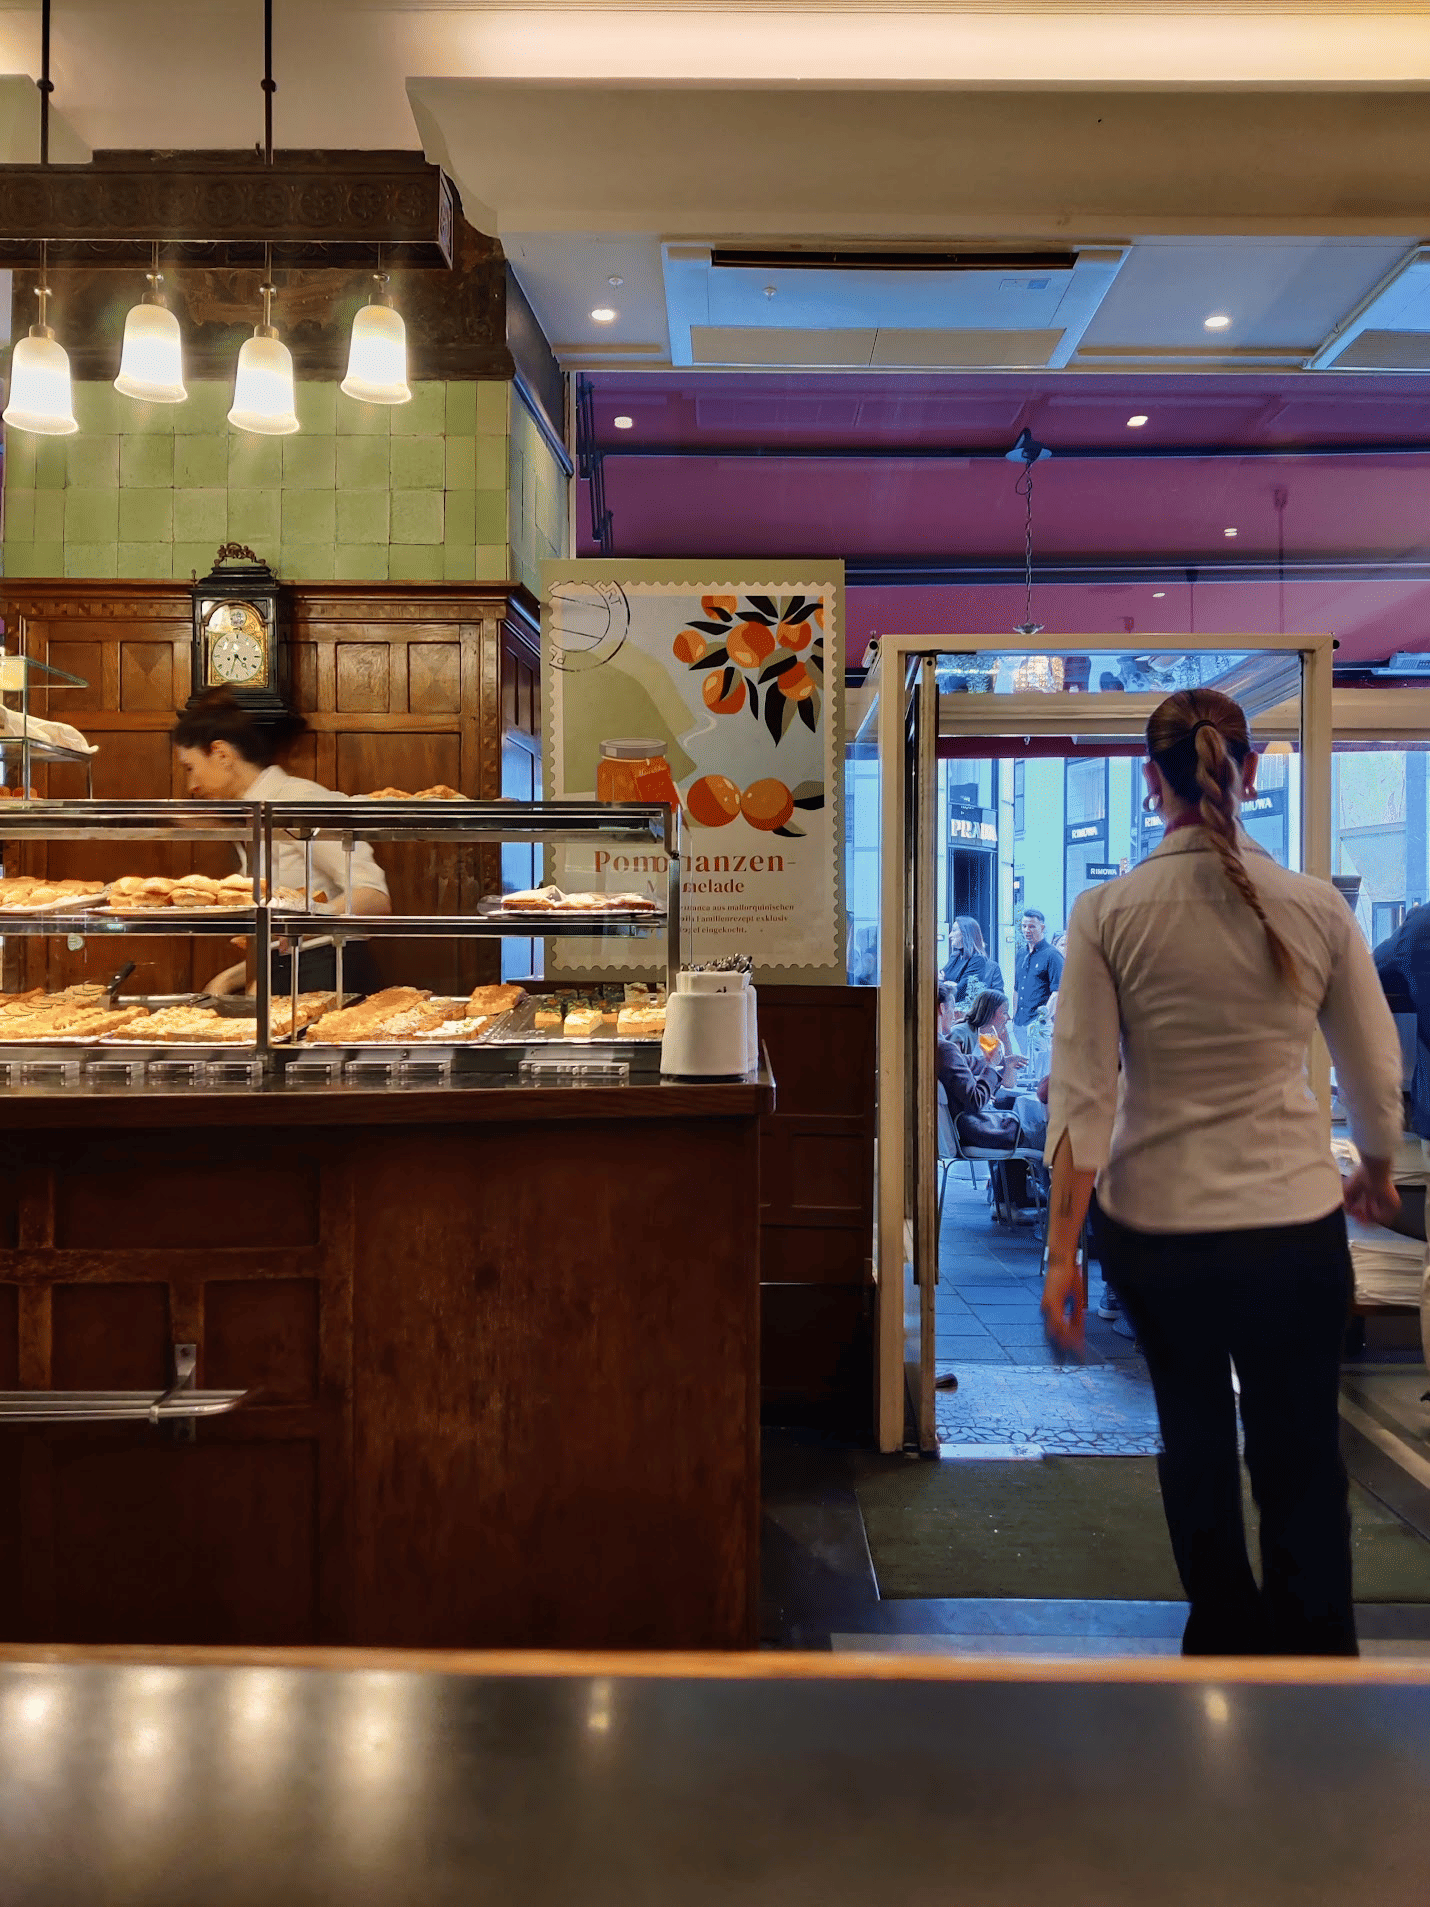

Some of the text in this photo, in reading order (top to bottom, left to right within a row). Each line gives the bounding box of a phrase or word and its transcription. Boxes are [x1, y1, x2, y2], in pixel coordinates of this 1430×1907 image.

[1240, 797, 1273, 813] IMOWA
[1071, 826, 1099, 839] RIMOWA
[1090, 867, 1118, 876] RIMOWA
[727, 903, 794, 913] mallorquinischen
[755, 914, 788, 922] exklusiv
